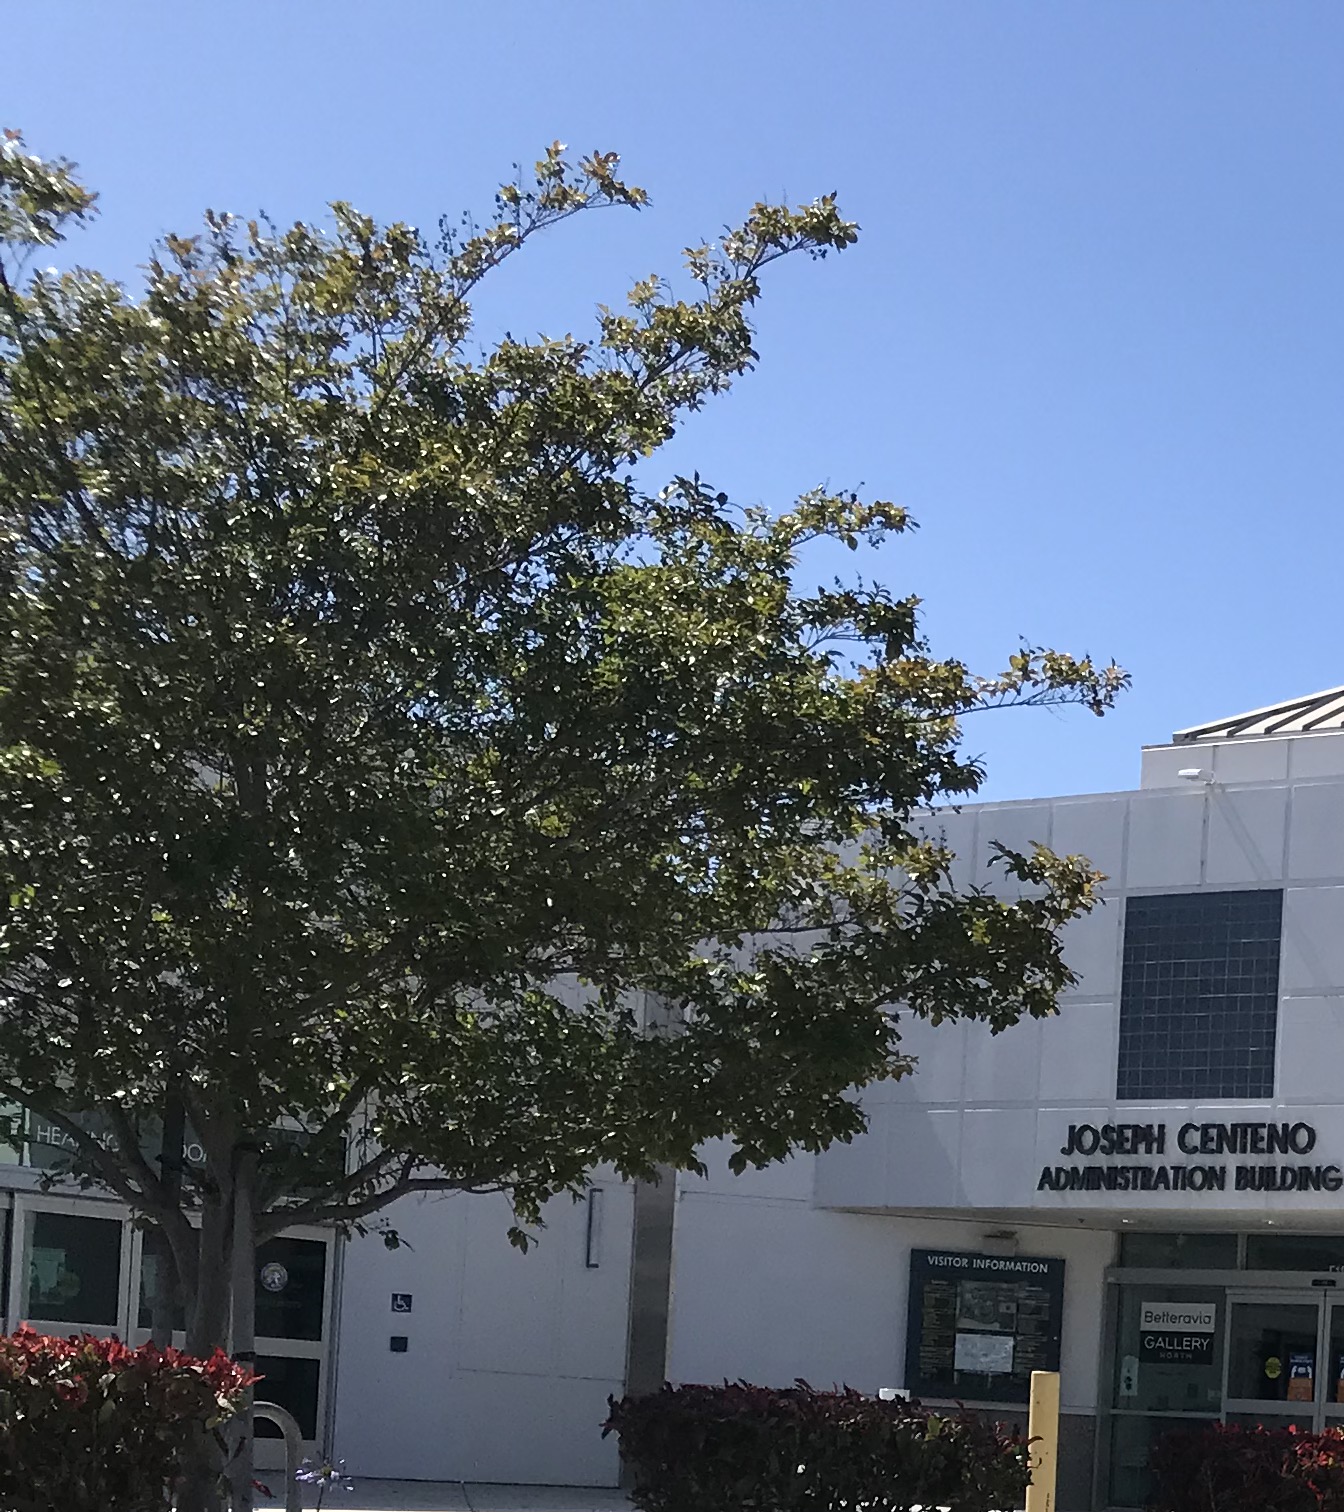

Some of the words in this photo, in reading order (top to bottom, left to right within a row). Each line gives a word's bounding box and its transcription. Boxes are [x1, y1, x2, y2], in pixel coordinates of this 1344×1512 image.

[1060, 1124, 1166, 1156] JOSEPH
[1177, 1122, 1317, 1155] CENTENO
[1036, 1165, 1227, 1192] ADMINISTRATION
[1234, 1165, 1344, 1192] BUILDING
[927, 1255, 969, 1268] VISITOR
[973, 1258, 1049, 1274] INFORMATION
[1144, 1311, 1212, 1325] Betteravia
[1144, 1336, 1210, 1351] GALLERY
